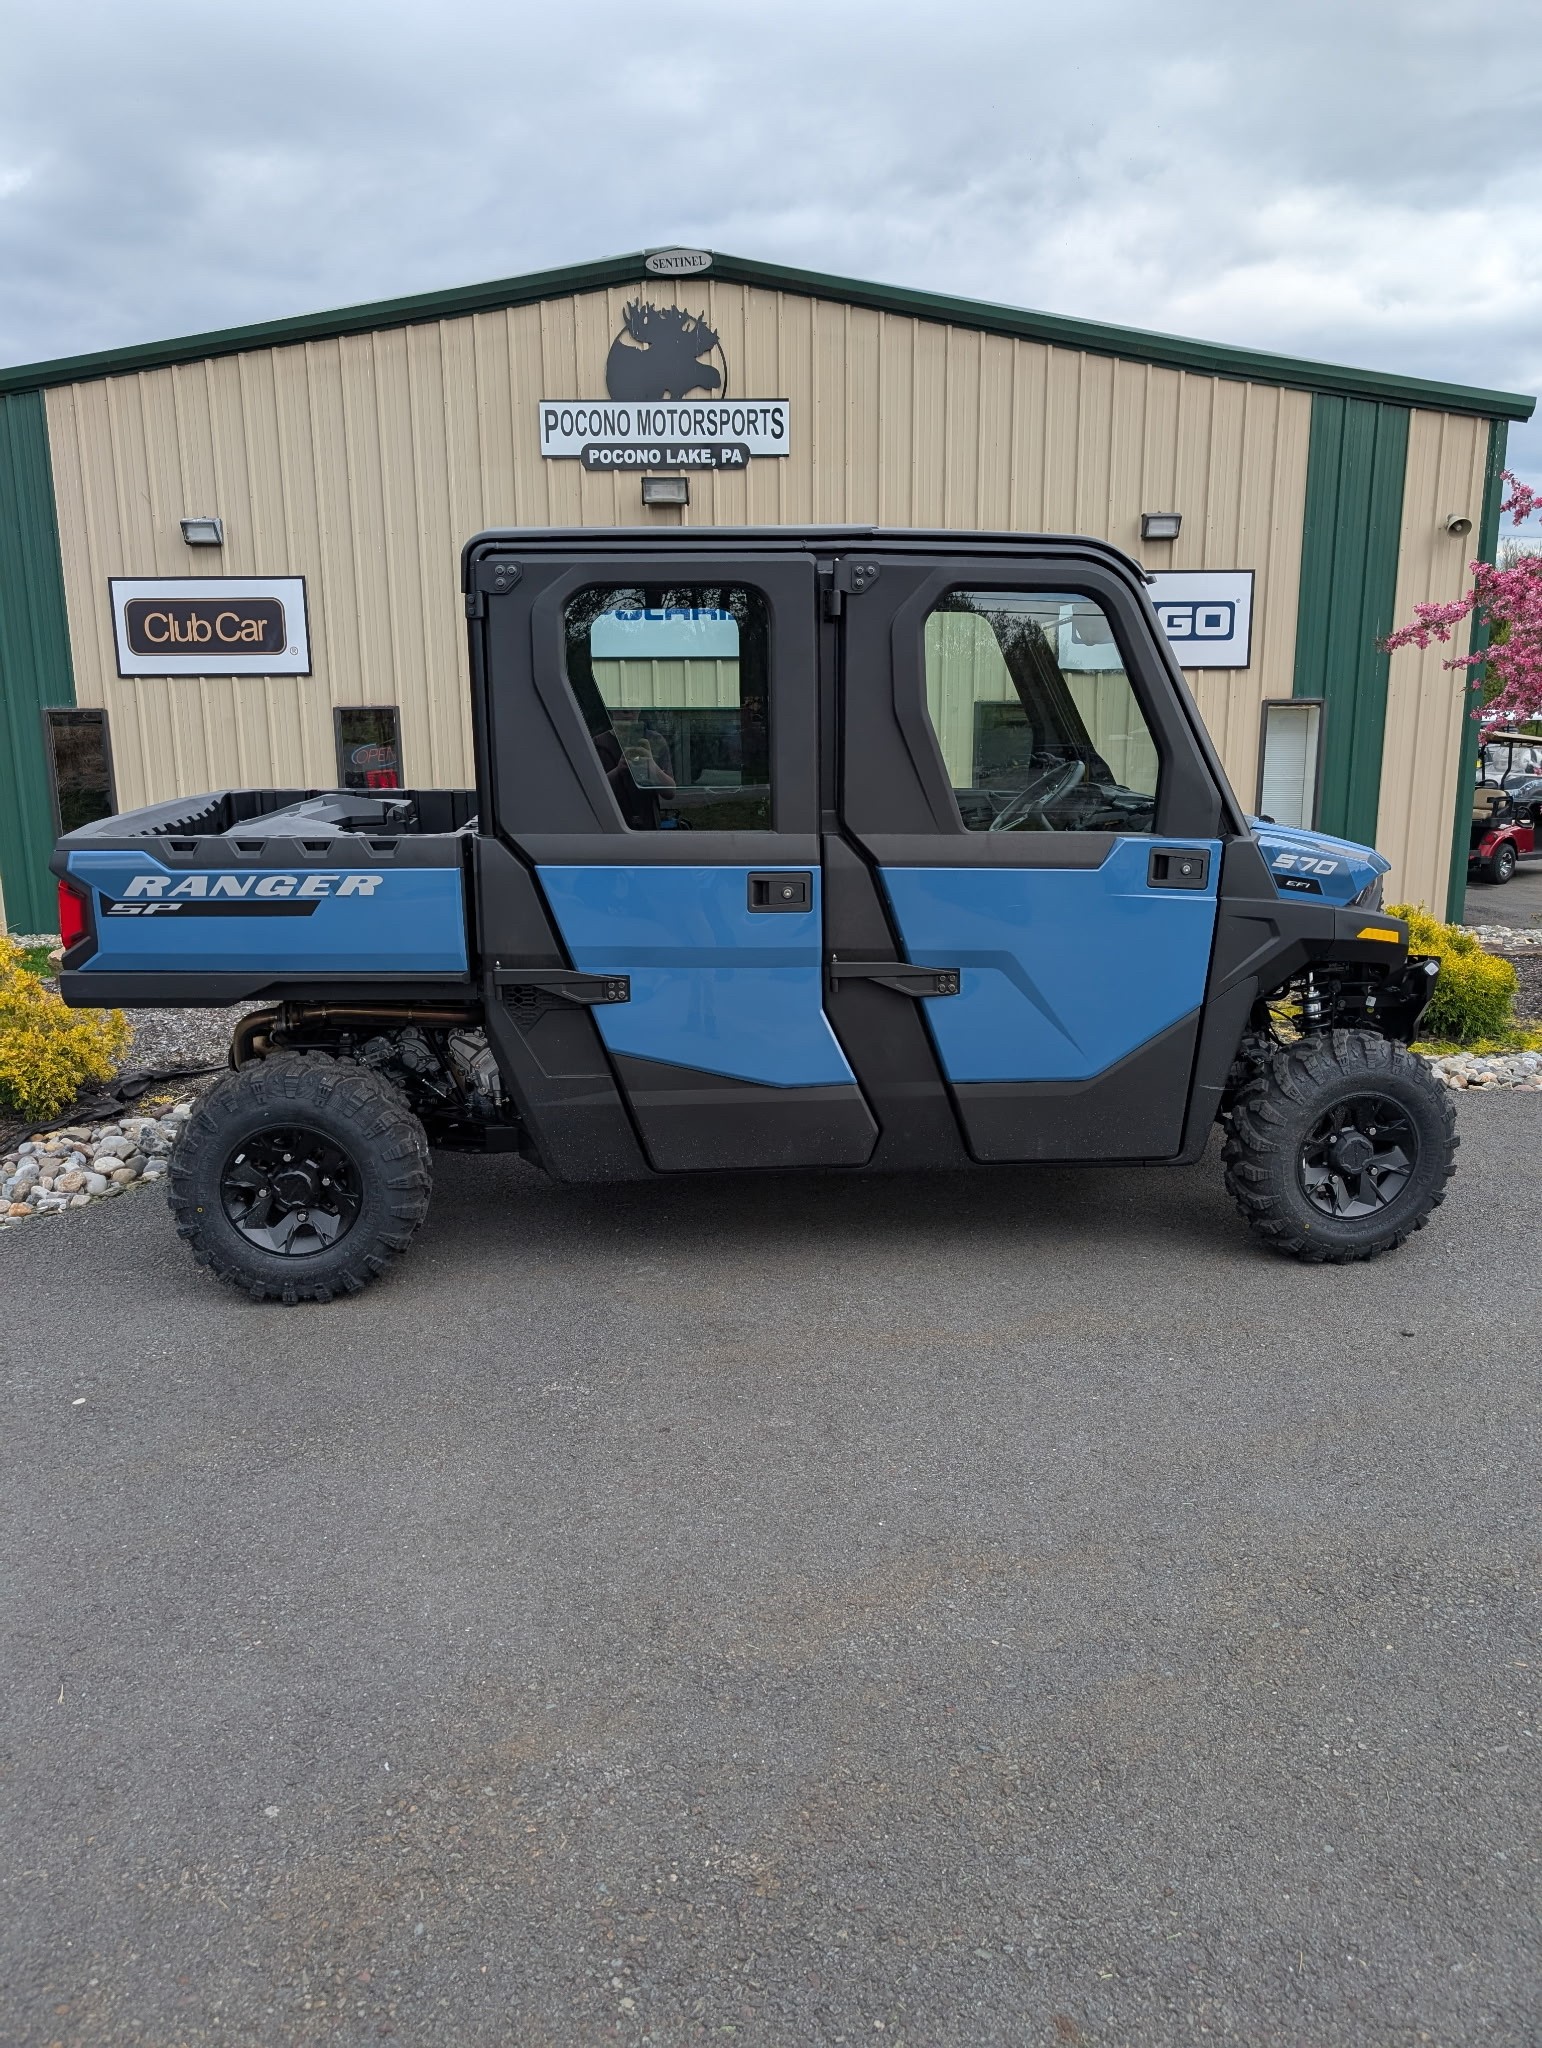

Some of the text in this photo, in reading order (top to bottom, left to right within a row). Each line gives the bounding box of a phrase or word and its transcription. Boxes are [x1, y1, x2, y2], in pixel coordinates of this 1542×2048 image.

[652, 255, 707, 269] SENTINEL
[544, 407, 784, 443] POCONO MOTORSPORTS
[588, 449, 743, 466] POCONO LAKE, PA
[144, 612, 268, 643] Club Car
[356, 746, 397, 764] OPEN
[1271, 853, 1339, 875] 570
[122, 875, 384, 897] RANGER
[1285, 880, 1311, 889] EFI
[107, 903, 184, 915] SP
